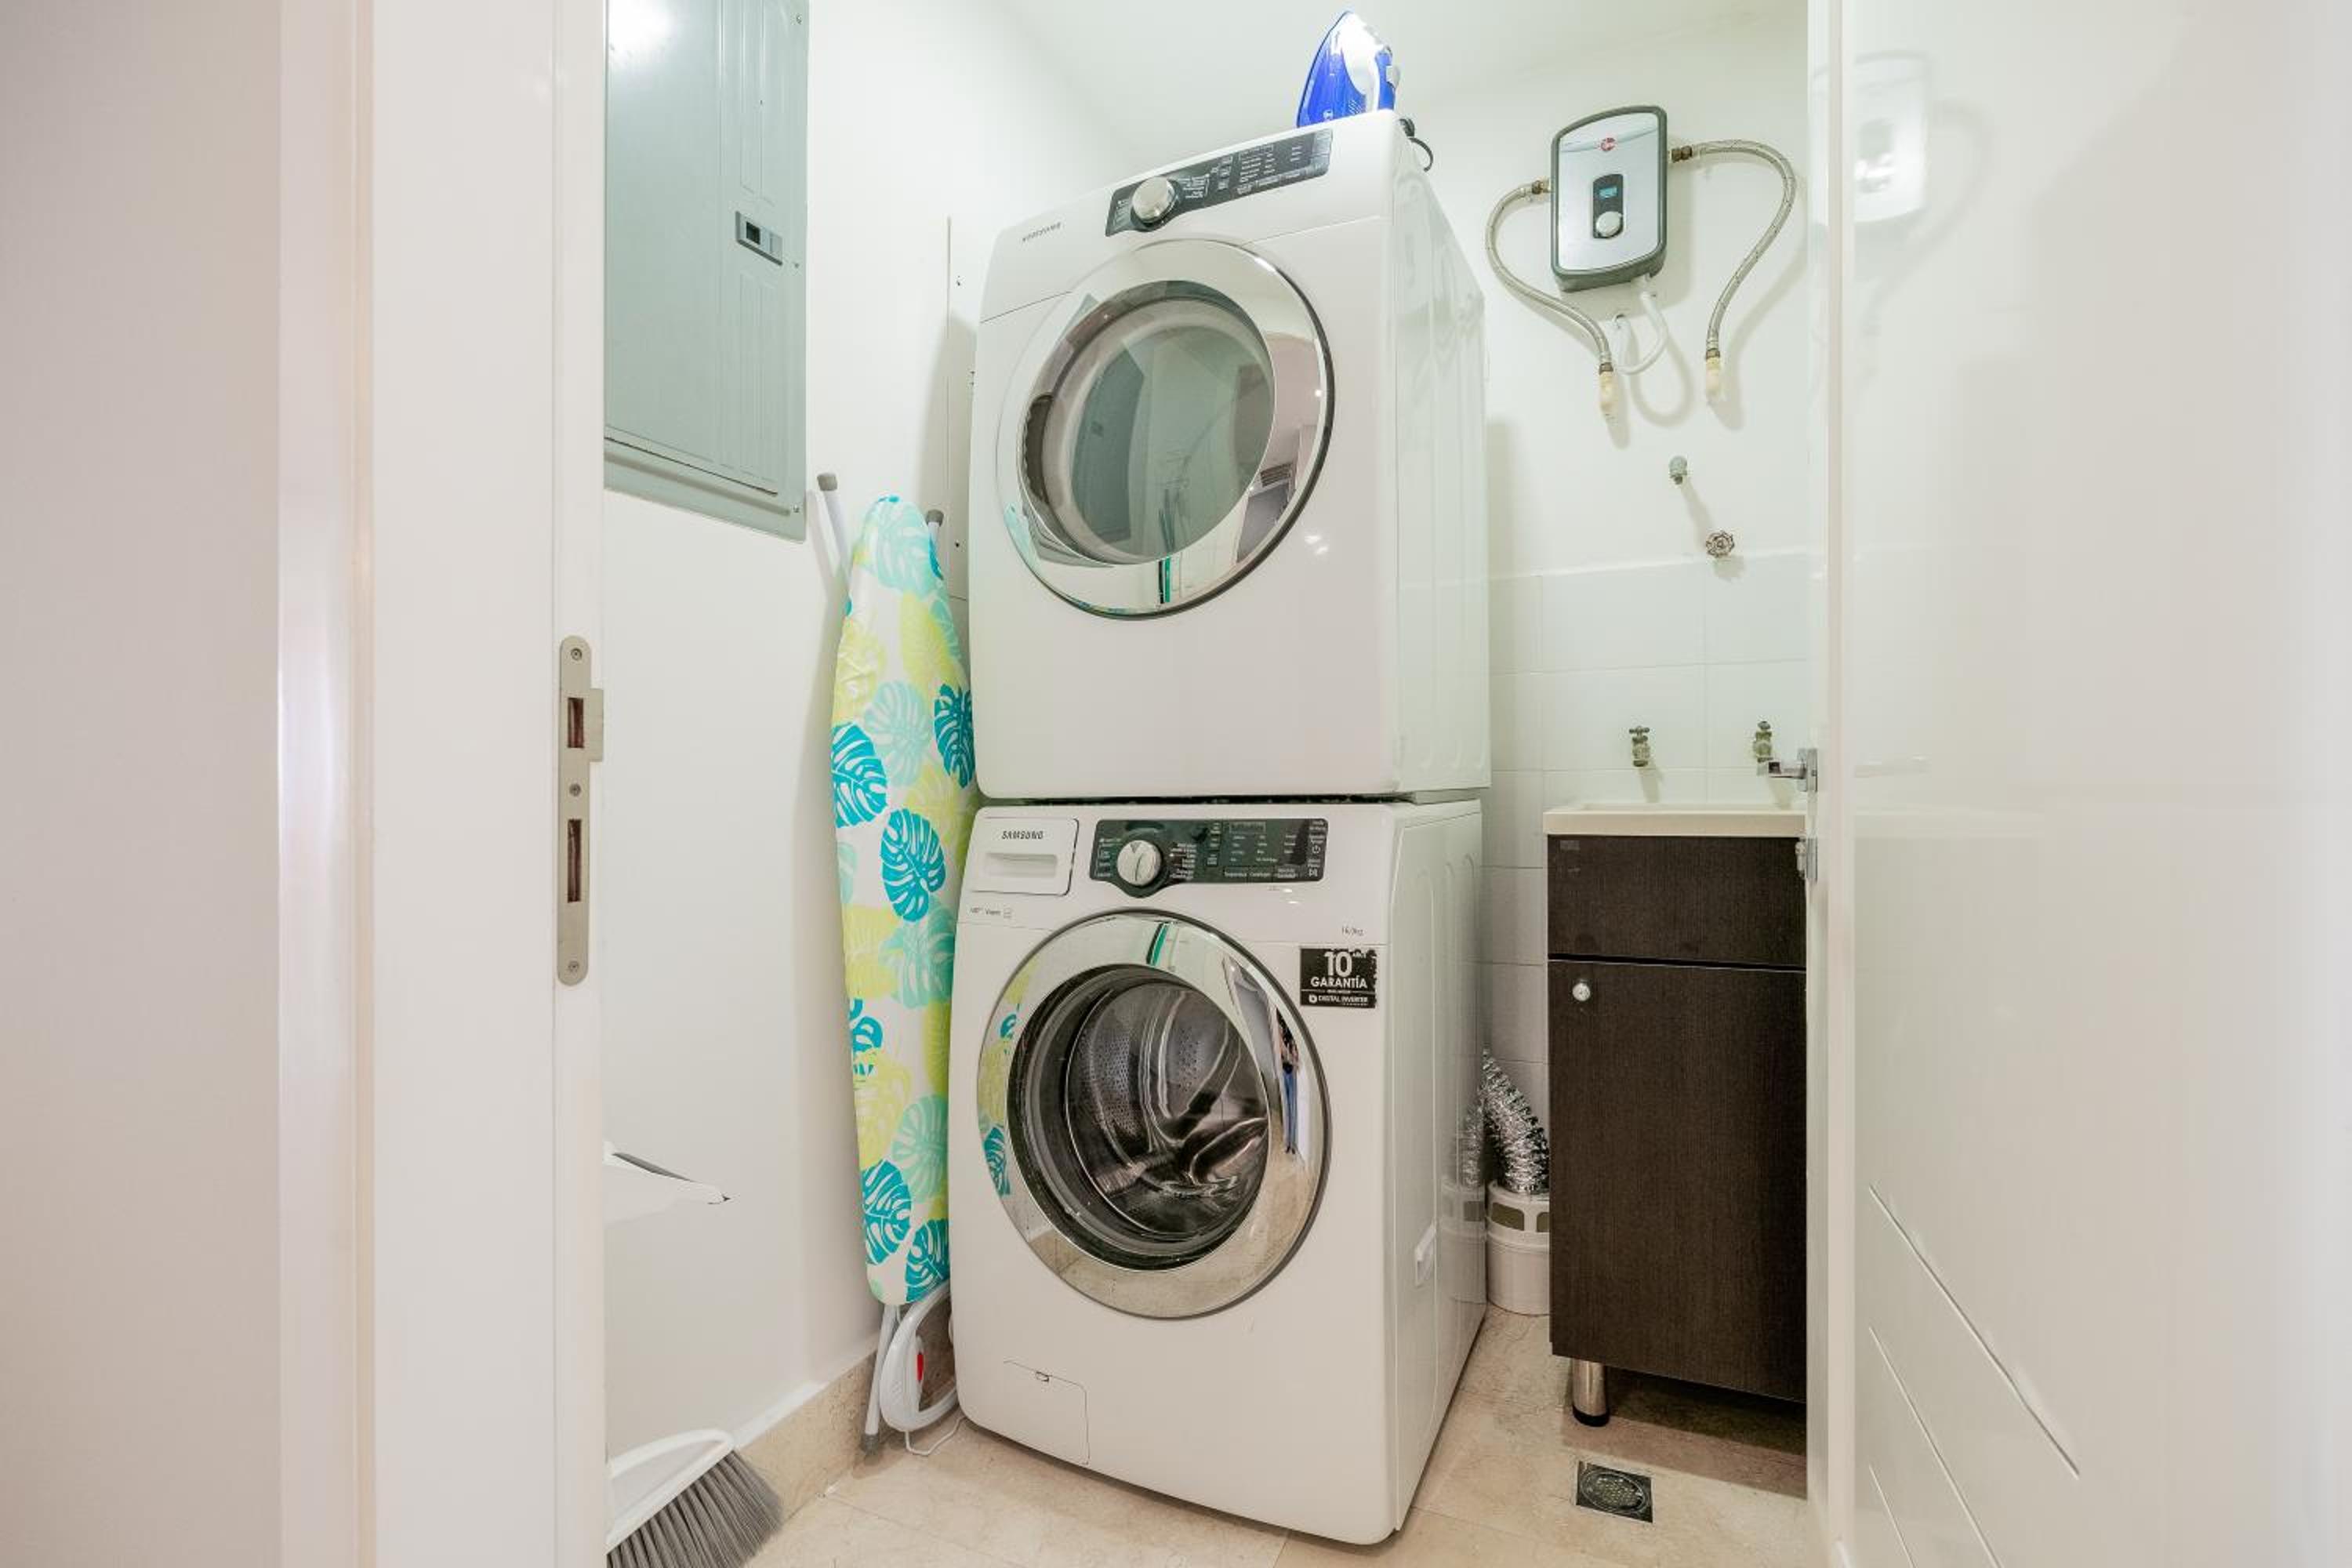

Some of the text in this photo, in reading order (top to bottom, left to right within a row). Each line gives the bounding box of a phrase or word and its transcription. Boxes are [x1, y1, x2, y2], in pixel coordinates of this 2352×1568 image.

[1001, 829, 1044, 840] SAMSUNG
[1323, 951, 1352, 978] 10
[1310, 975, 1368, 988] GARANTÍA
